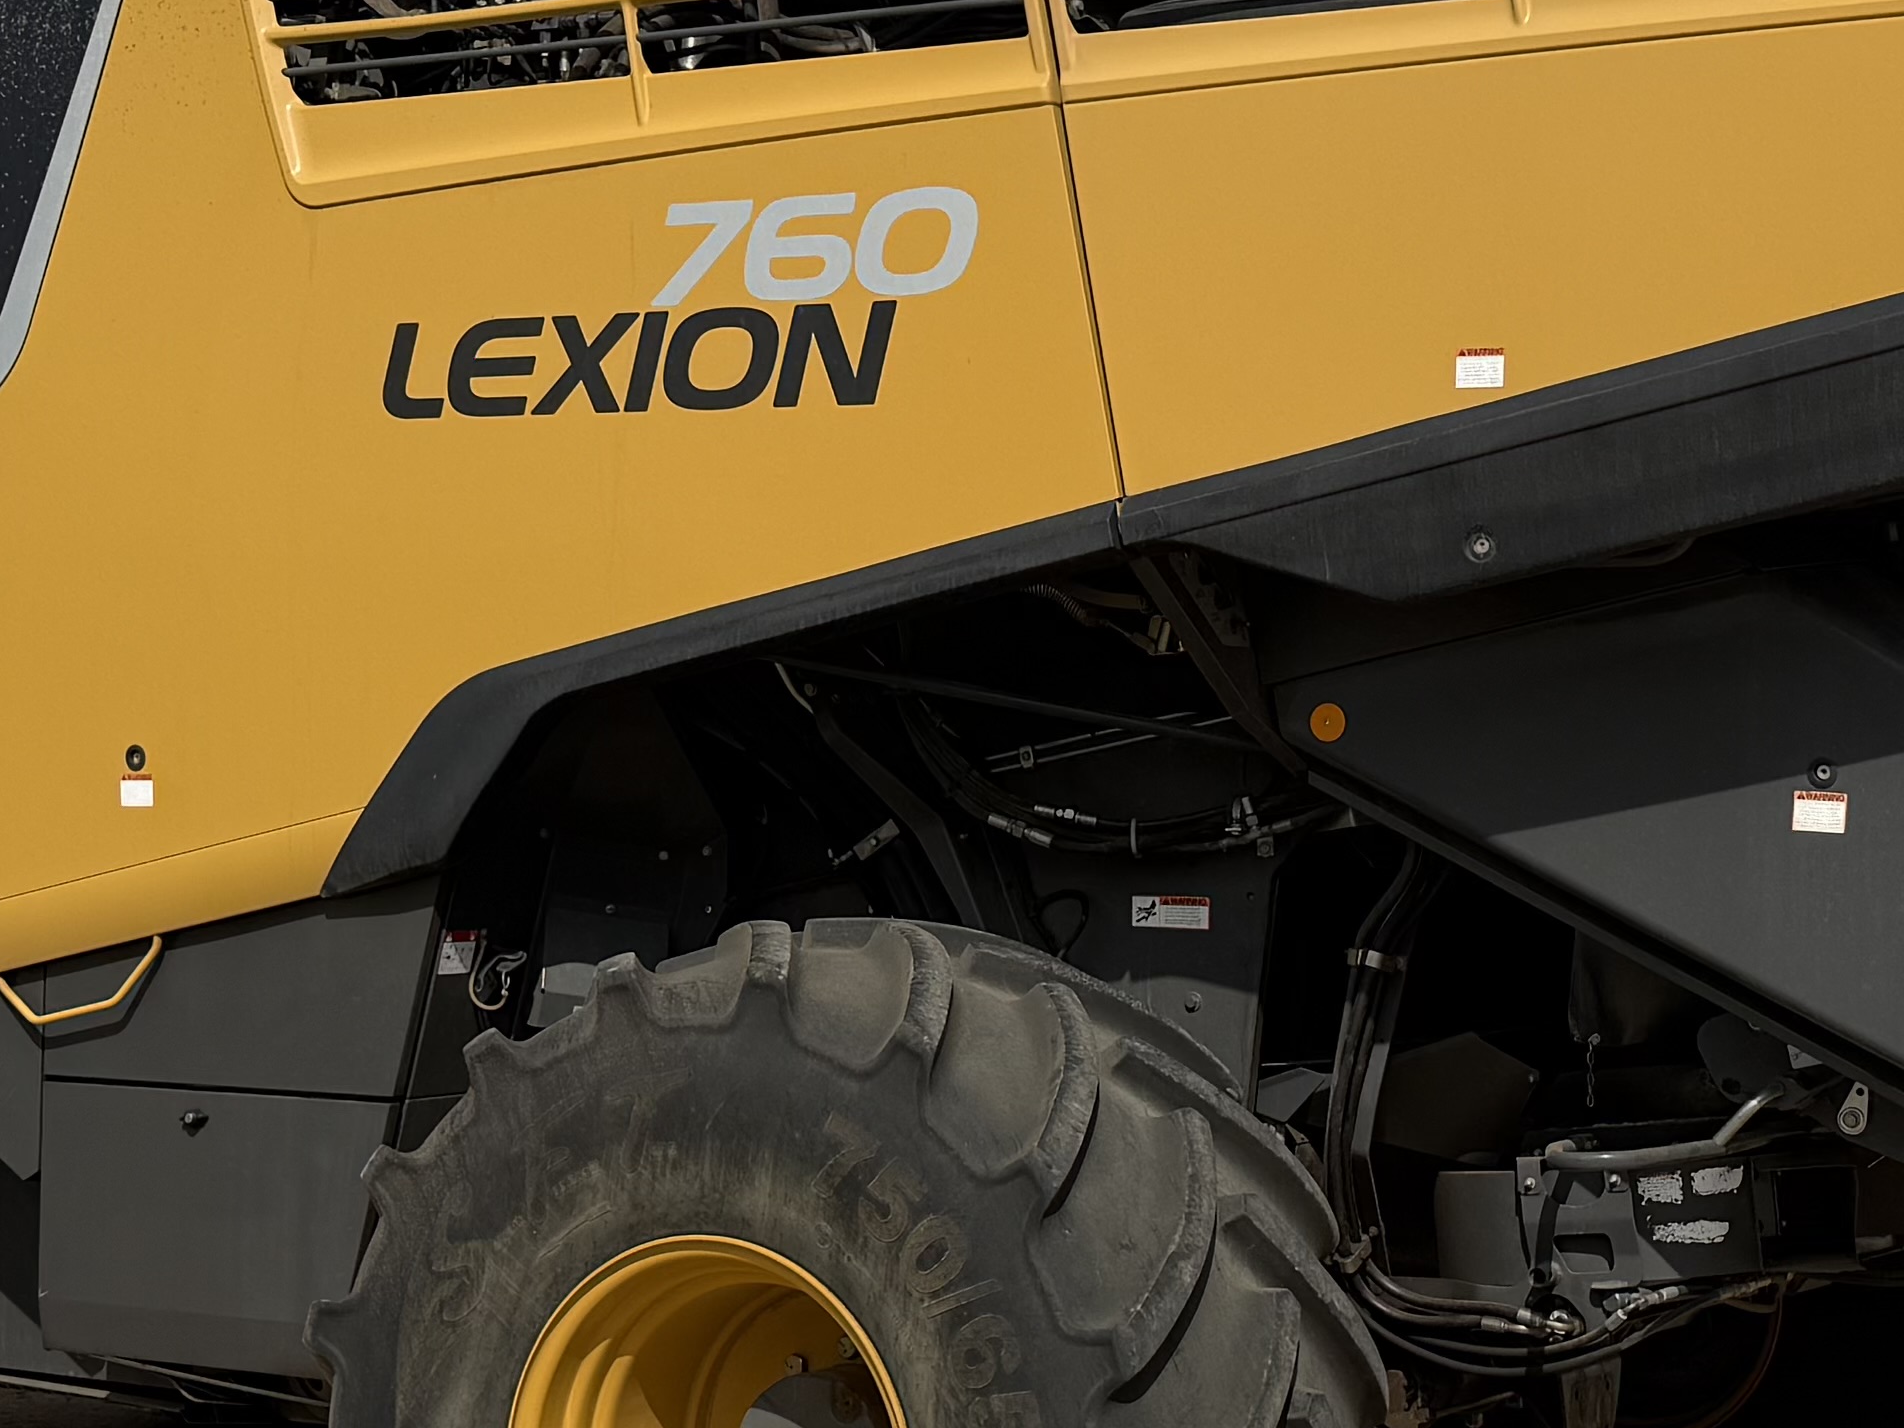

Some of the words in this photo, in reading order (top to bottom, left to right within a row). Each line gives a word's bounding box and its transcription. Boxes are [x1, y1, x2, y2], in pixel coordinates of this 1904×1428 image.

[650, 186, 980, 307] 760
[382, 299, 897, 420] LEXION
[1806, 791, 1845, 802] WARNING
